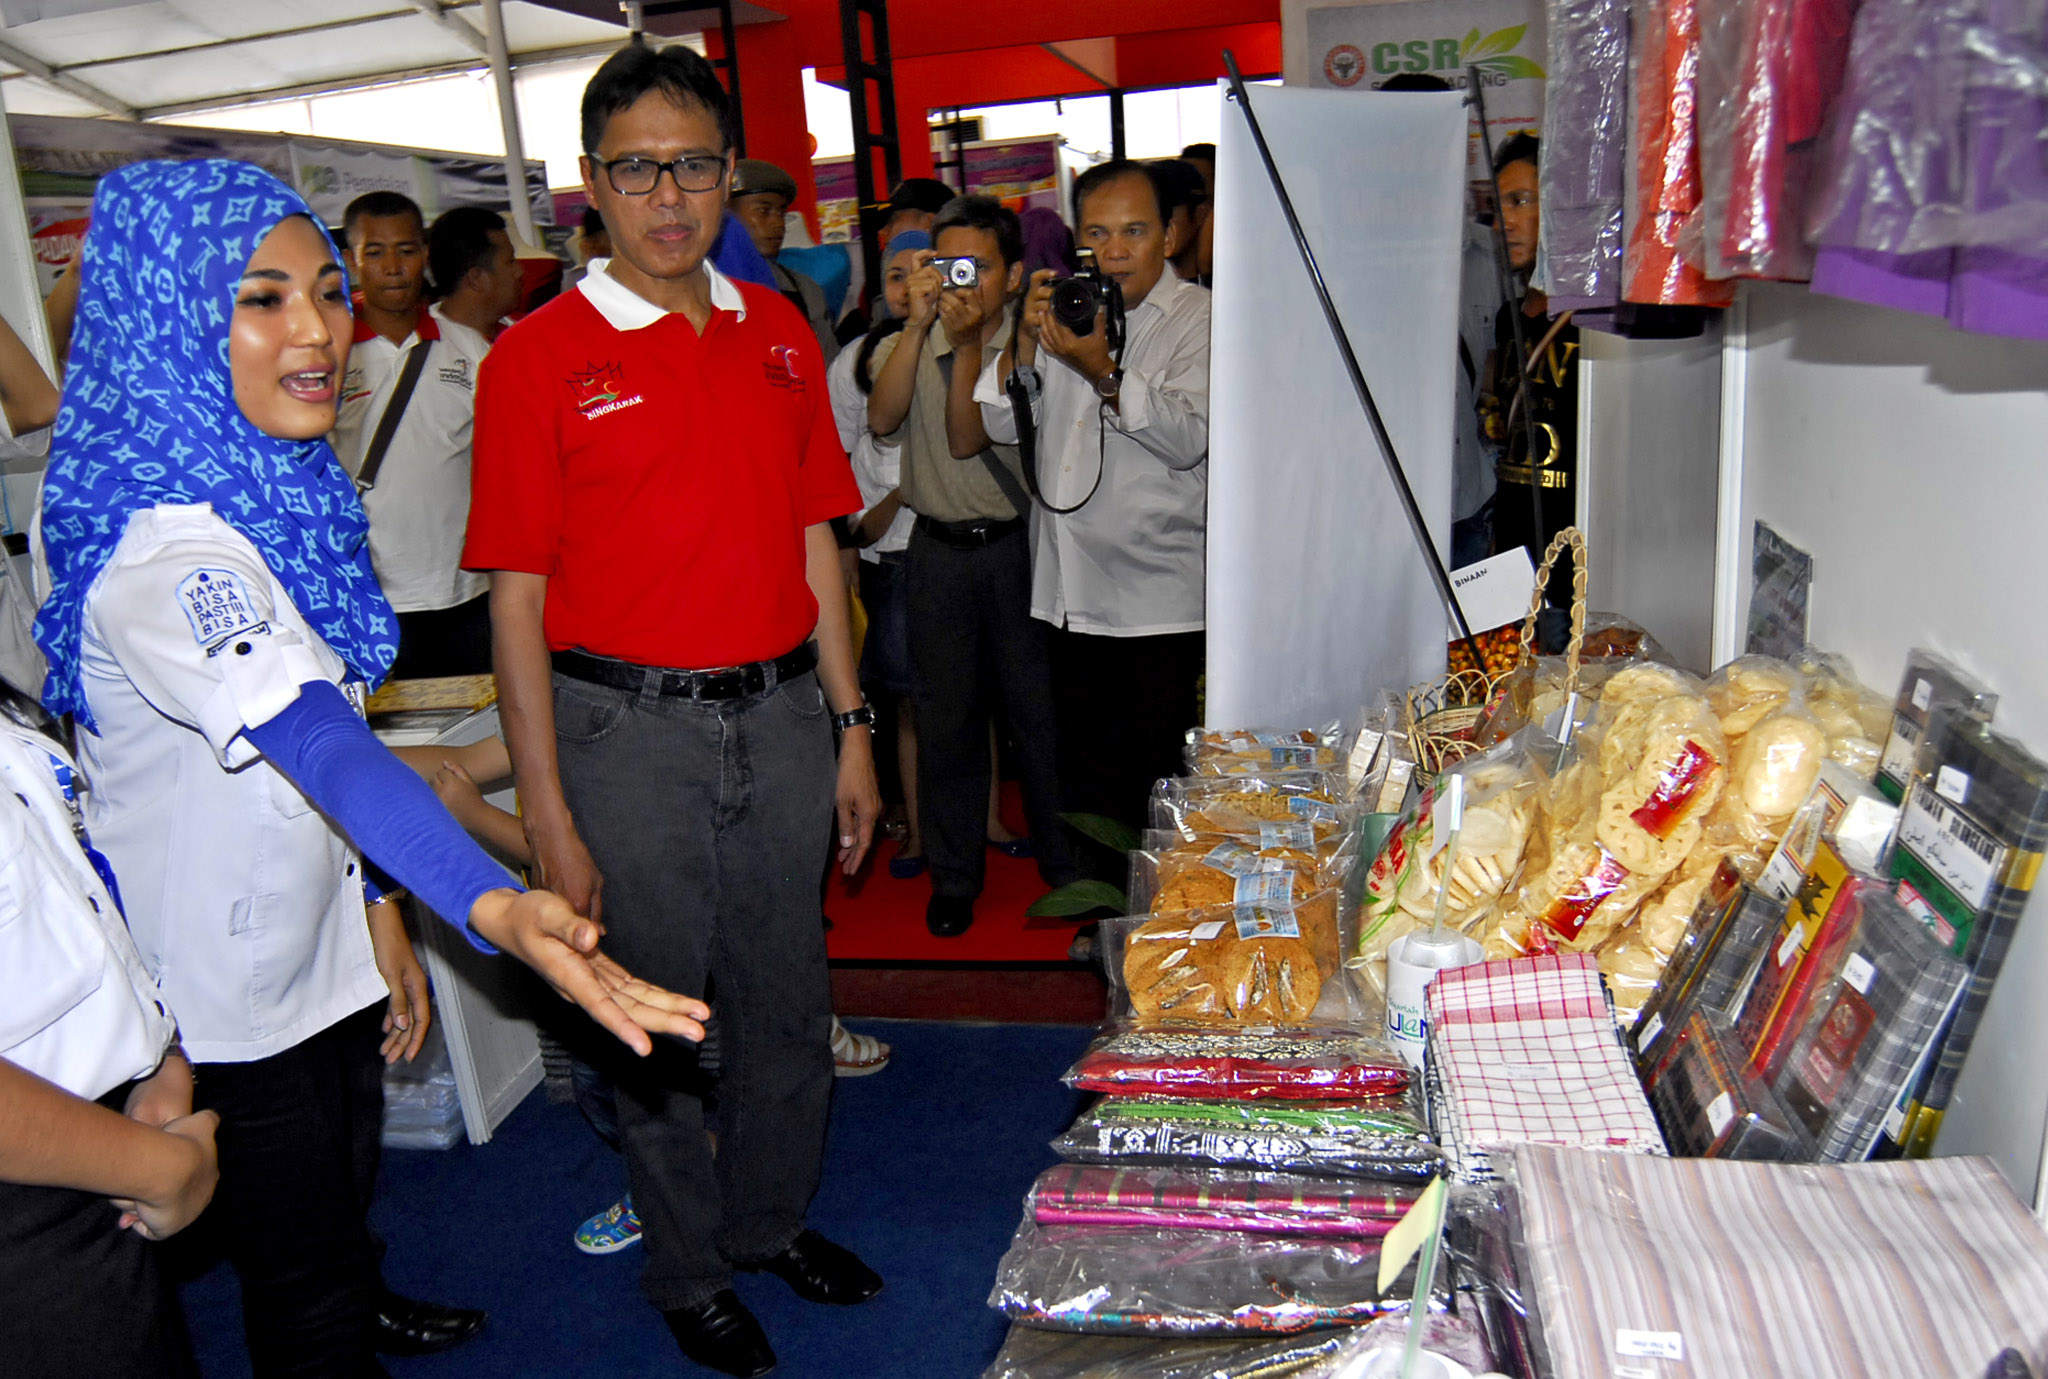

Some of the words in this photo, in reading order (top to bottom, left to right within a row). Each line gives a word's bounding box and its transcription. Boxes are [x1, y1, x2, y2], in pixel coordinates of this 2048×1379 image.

[1372, 38, 1459, 75] CSR
[586, 394, 643, 421] SINGKARAK
[1454, 568, 1487, 588] BINAAN
[186, 579, 233, 602] YAKIN
[193, 590, 238, 614] BISA
[203, 613, 249, 636] BISA
